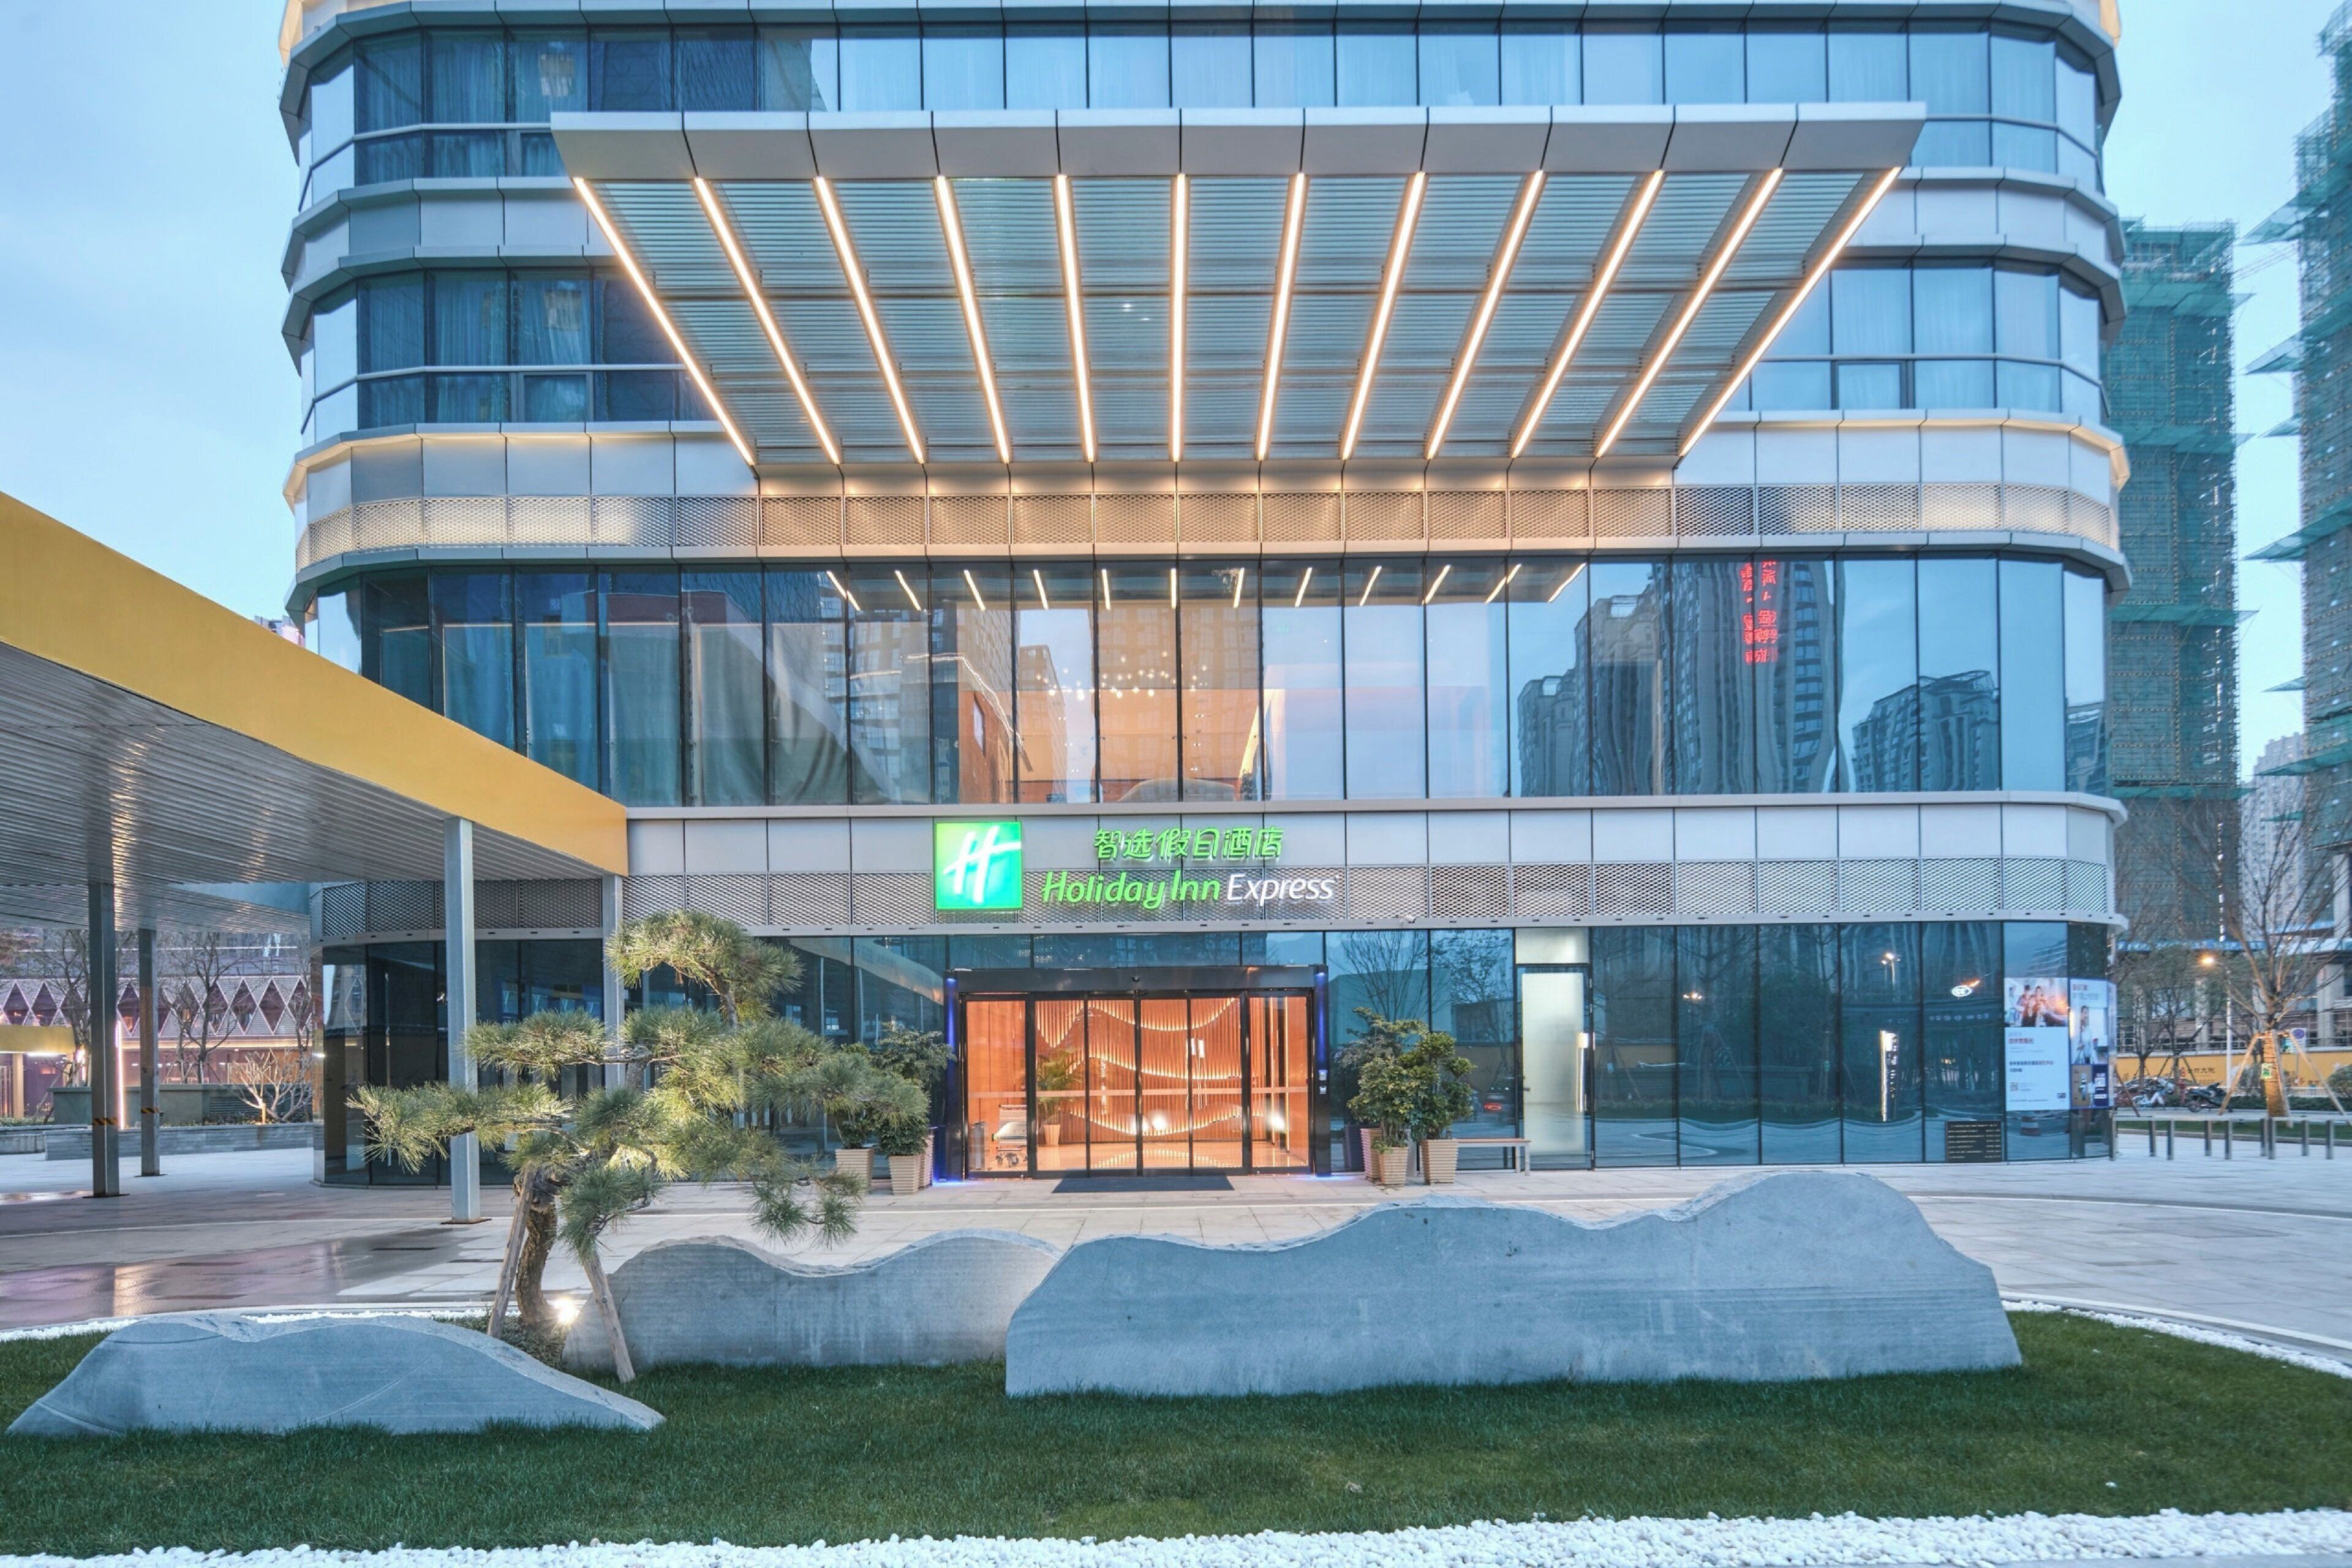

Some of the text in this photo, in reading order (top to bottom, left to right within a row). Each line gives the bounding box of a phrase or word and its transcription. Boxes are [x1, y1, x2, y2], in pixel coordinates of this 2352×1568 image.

[1094, 827, 1284, 859] 智选假日酒店
[1042, 869, 1336, 910] Holiday Inn Express
